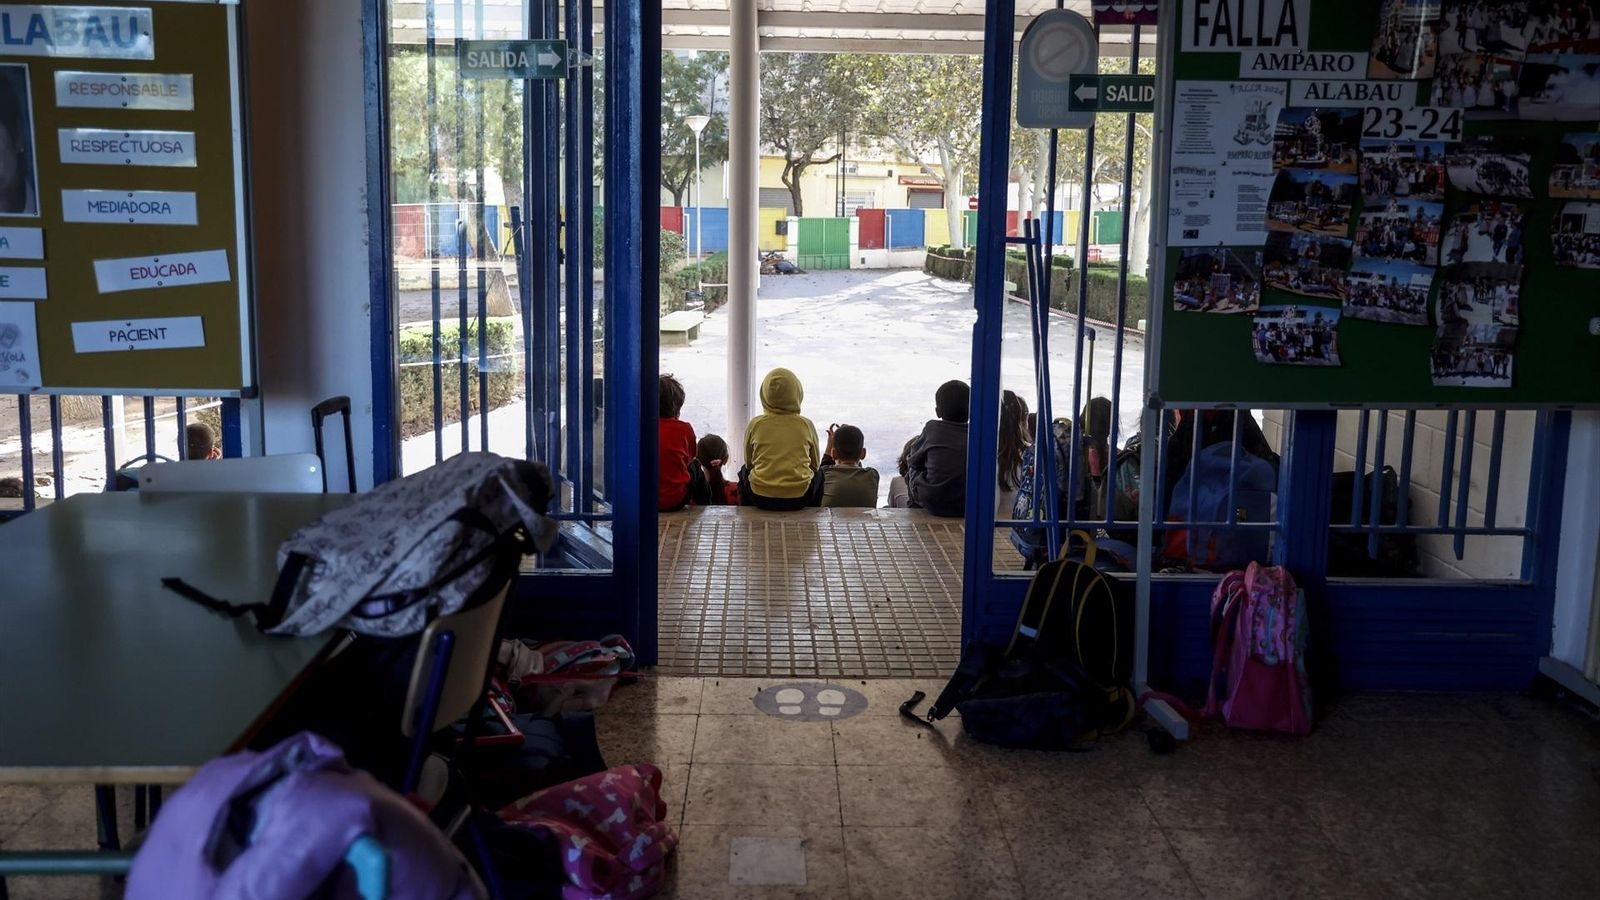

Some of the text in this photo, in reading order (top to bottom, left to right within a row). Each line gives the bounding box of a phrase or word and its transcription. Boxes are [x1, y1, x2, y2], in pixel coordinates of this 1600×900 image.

[1193, 0, 1299, 47] FALLA
[467, 51, 530, 68] SALIDA
[1251, 52, 1355, 73] AMPARO
[68, 81, 179, 97] RESPONSABLE
[1303, 82, 1403, 101] ALABAU
[1362, 106, 1462, 140] 23-24
[70, 139, 184, 154] RESPECTUOSA
[87, 200, 172, 215] MEDIADORA
[129, 262, 198, 281] EDUCADA
[108, 327, 168, 343] PACIENT
